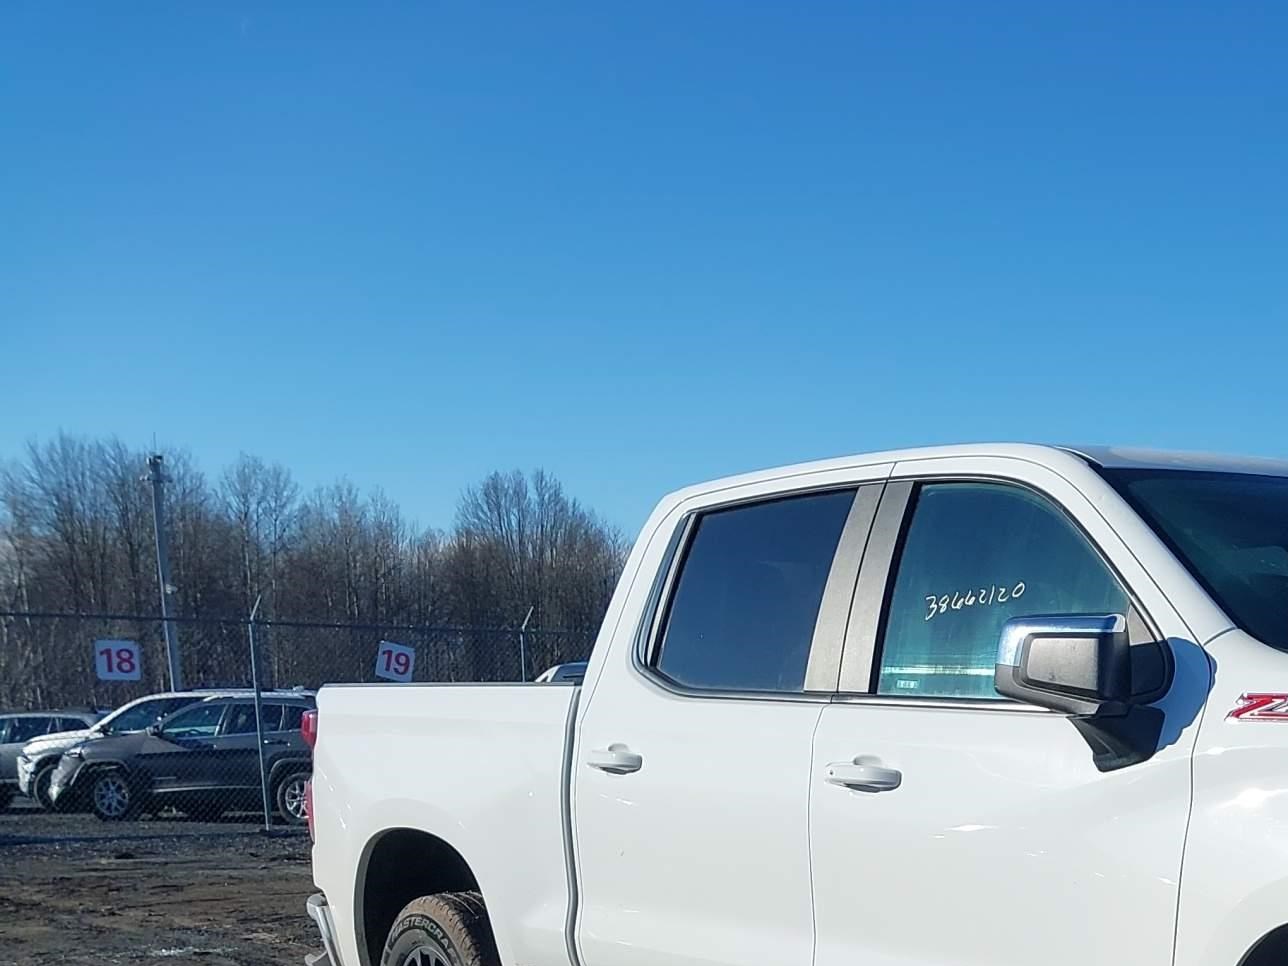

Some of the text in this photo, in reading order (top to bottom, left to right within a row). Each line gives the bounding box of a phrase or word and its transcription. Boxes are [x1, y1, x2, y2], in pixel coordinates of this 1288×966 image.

[925, 581, 1026, 621] 38662120
[99, 648, 136, 673] 18
[382, 650, 410, 675] 19
